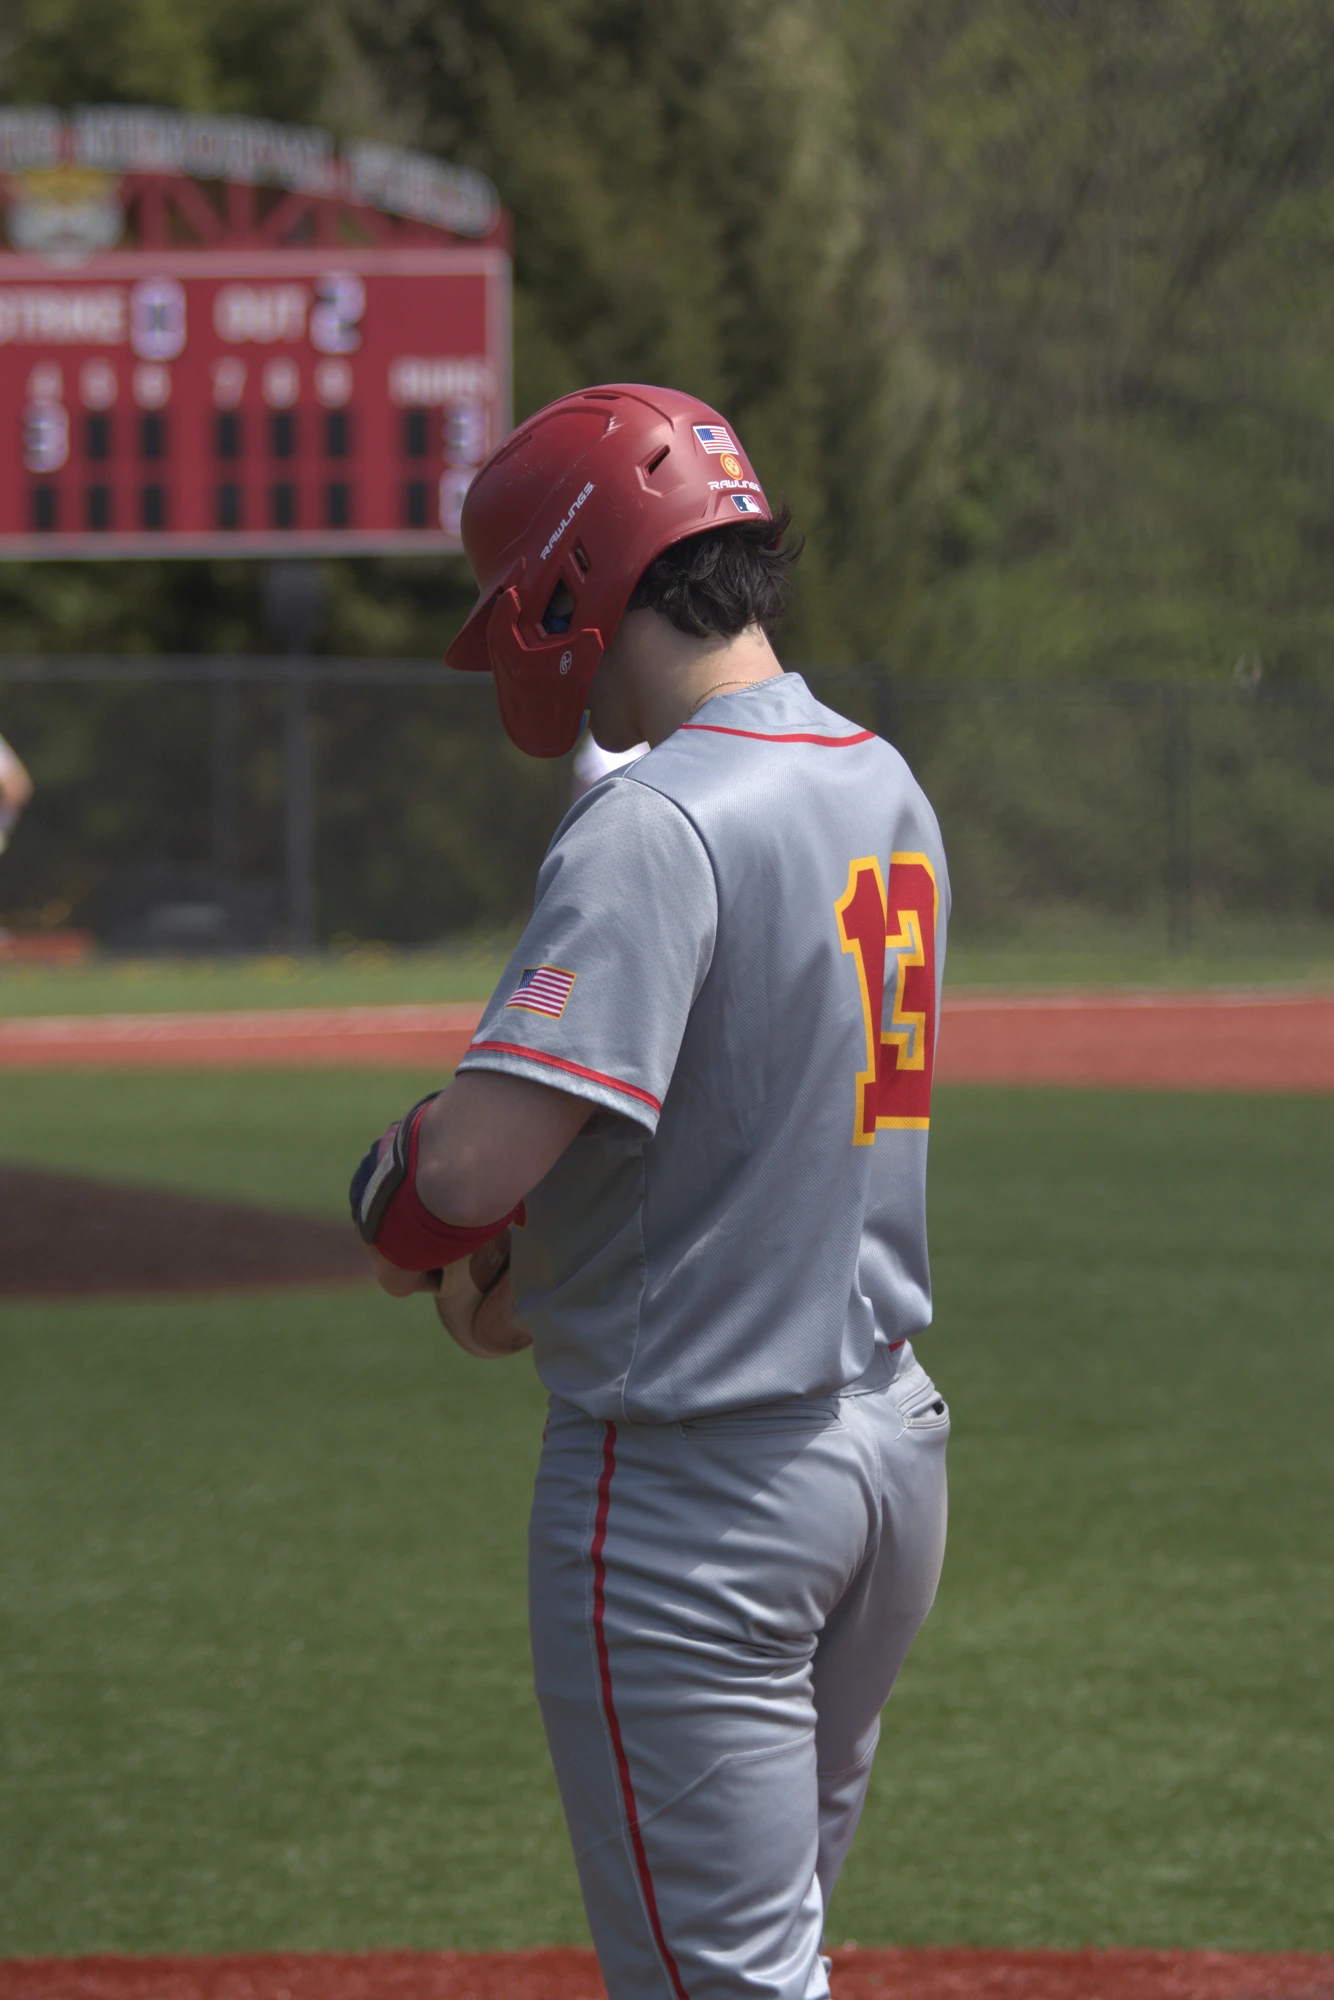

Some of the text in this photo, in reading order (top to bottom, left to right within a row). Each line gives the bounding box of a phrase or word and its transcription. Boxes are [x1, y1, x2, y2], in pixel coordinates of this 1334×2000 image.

[310, 270, 366, 354] 2
[540, 481, 595, 560] RAWLINGS
[833, 851, 939, 1147] 13
